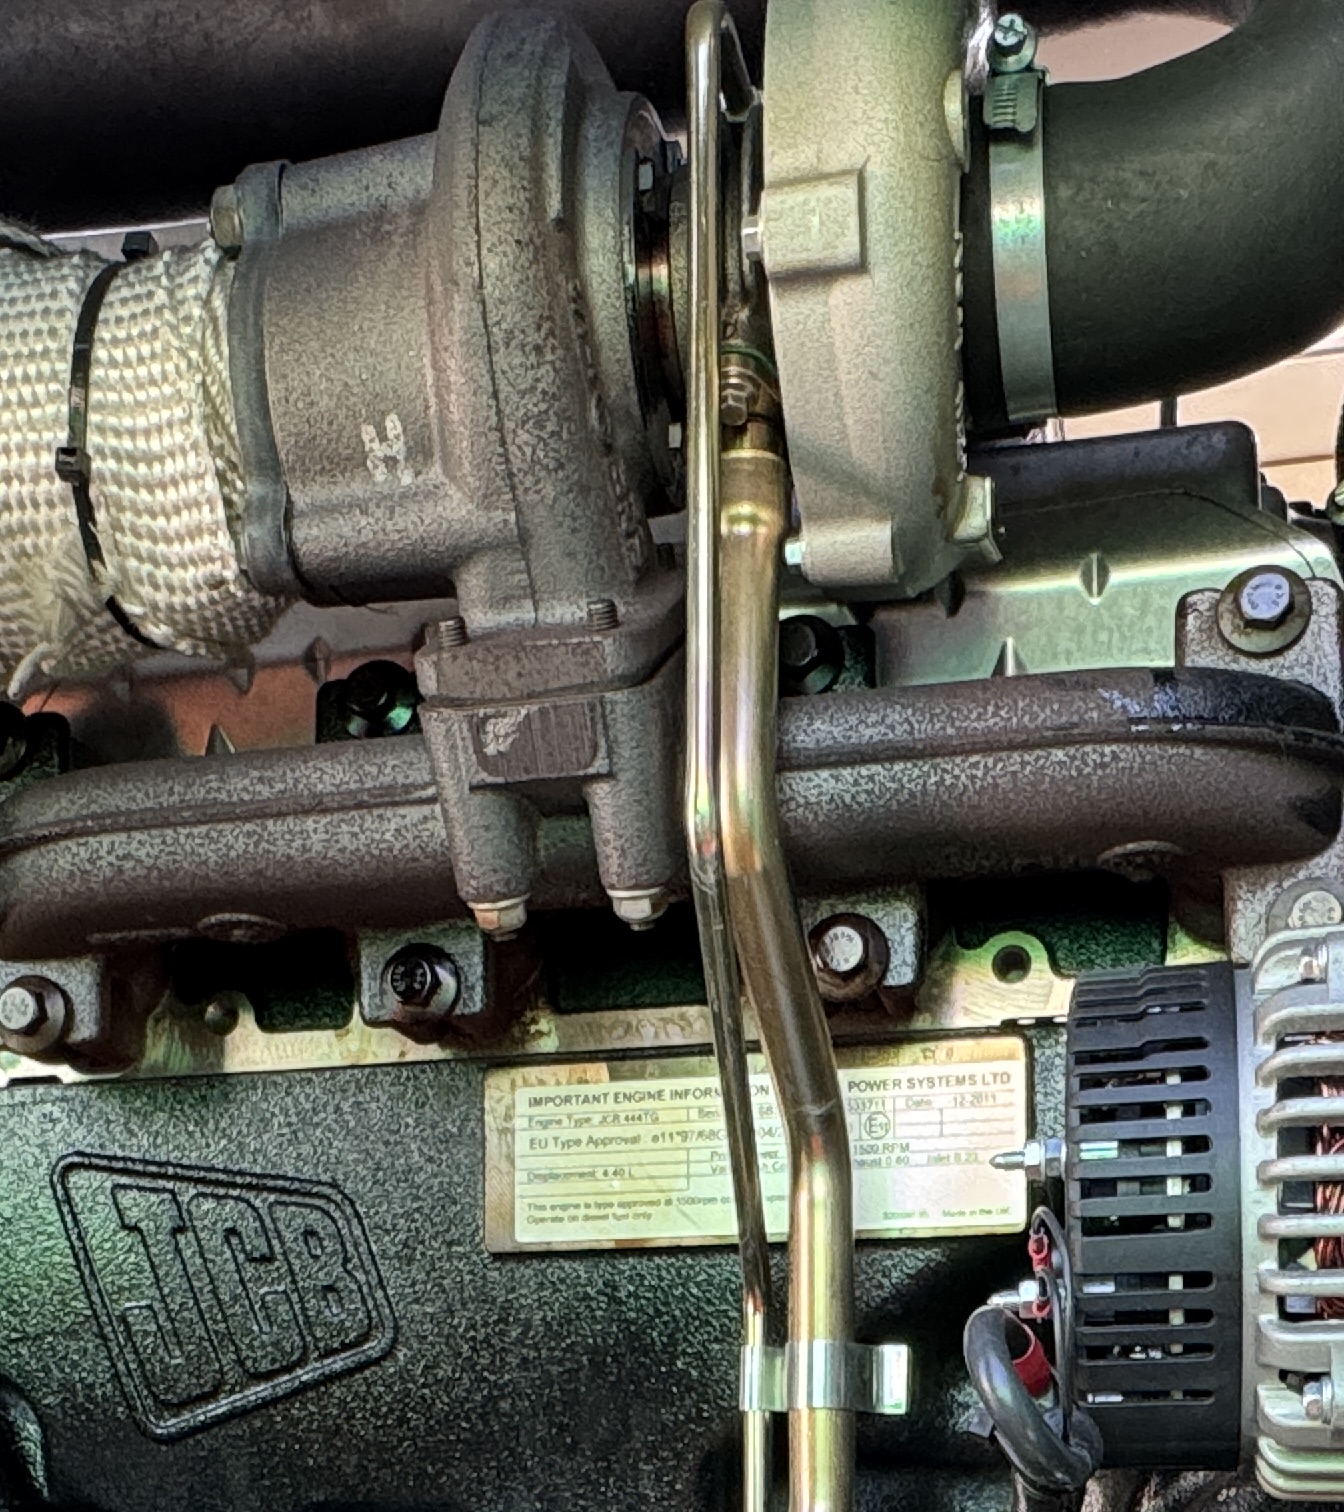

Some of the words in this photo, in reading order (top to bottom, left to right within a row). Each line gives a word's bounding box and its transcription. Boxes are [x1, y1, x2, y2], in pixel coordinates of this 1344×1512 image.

[848, 1078, 902, 1093] POWER
[906, 1074, 978, 1090] SYSTEMS
[982, 1071, 1011, 1086] LTD
[528, 1091, 610, 1108] IMPORTANT
[613, 1088, 666, 1105] ENGINE
[528, 1137, 549, 1151] EU
[552, 1136, 584, 1151] Type
[111, 1183, 373, 1404] JCB
